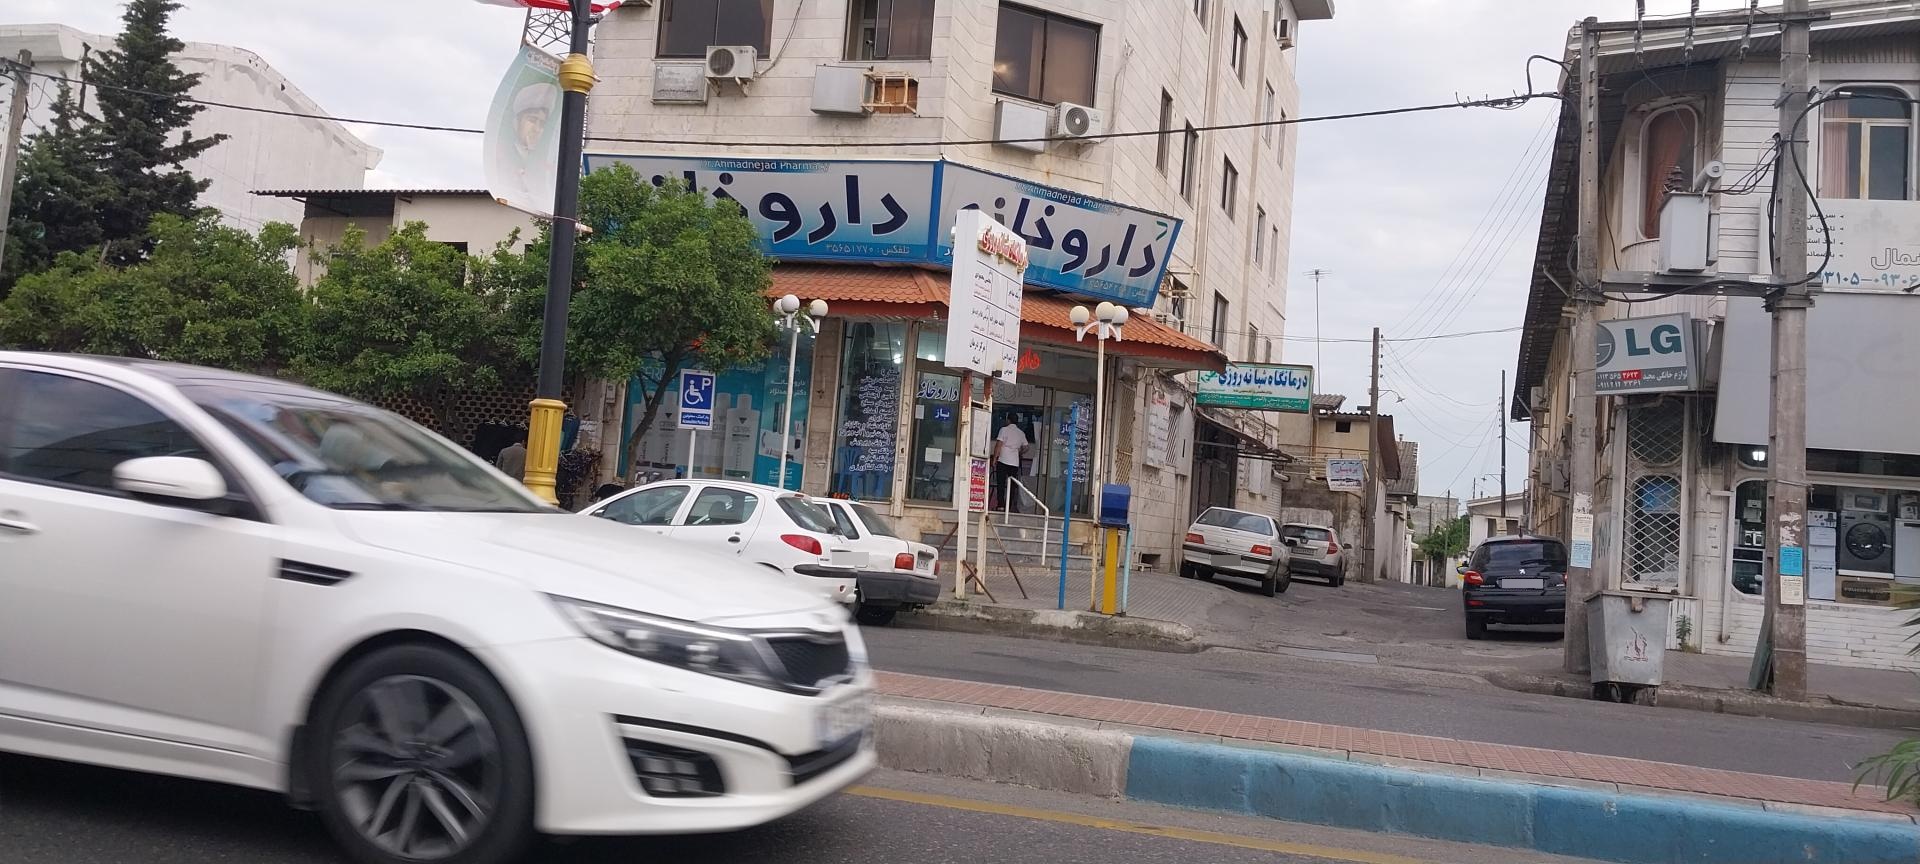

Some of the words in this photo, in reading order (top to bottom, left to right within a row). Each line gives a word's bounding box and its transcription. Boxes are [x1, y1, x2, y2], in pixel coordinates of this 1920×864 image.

[714, 159, 777, 171] Ahmadnejad
[1625, 324, 1683, 357] LG
[702, 377, 711, 390] P
[1244, 369, 1266, 389] شبانه
[1270, 370, 1308, 390] درمانگاه
[916, 379, 959, 401] داروخانه
[935, 408, 950, 419] باز
